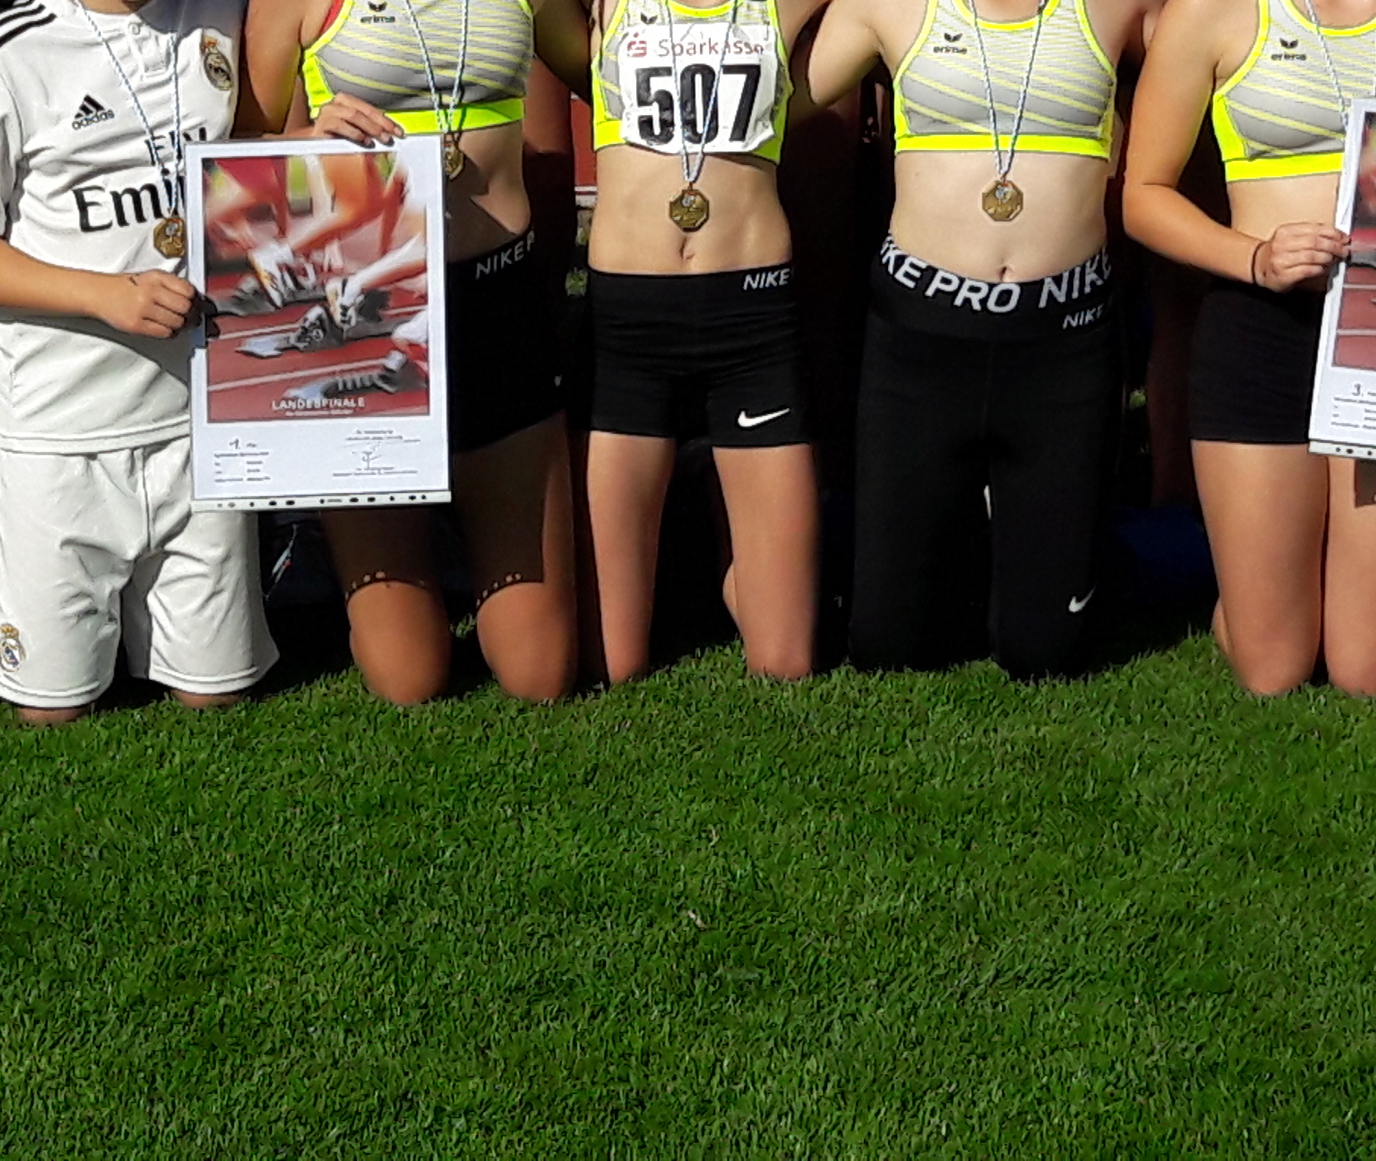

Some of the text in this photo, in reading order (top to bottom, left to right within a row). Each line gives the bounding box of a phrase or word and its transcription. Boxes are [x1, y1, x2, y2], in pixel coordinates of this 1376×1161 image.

[657, 38, 765, 58] Sparkasse
[634, 63, 761, 145] 507
[71, 109, 115, 131] adidas
[475, 241, 525, 280] NIKE
[742, 267, 791, 291] NIKE
[925, 267, 1021, 314] PRO
